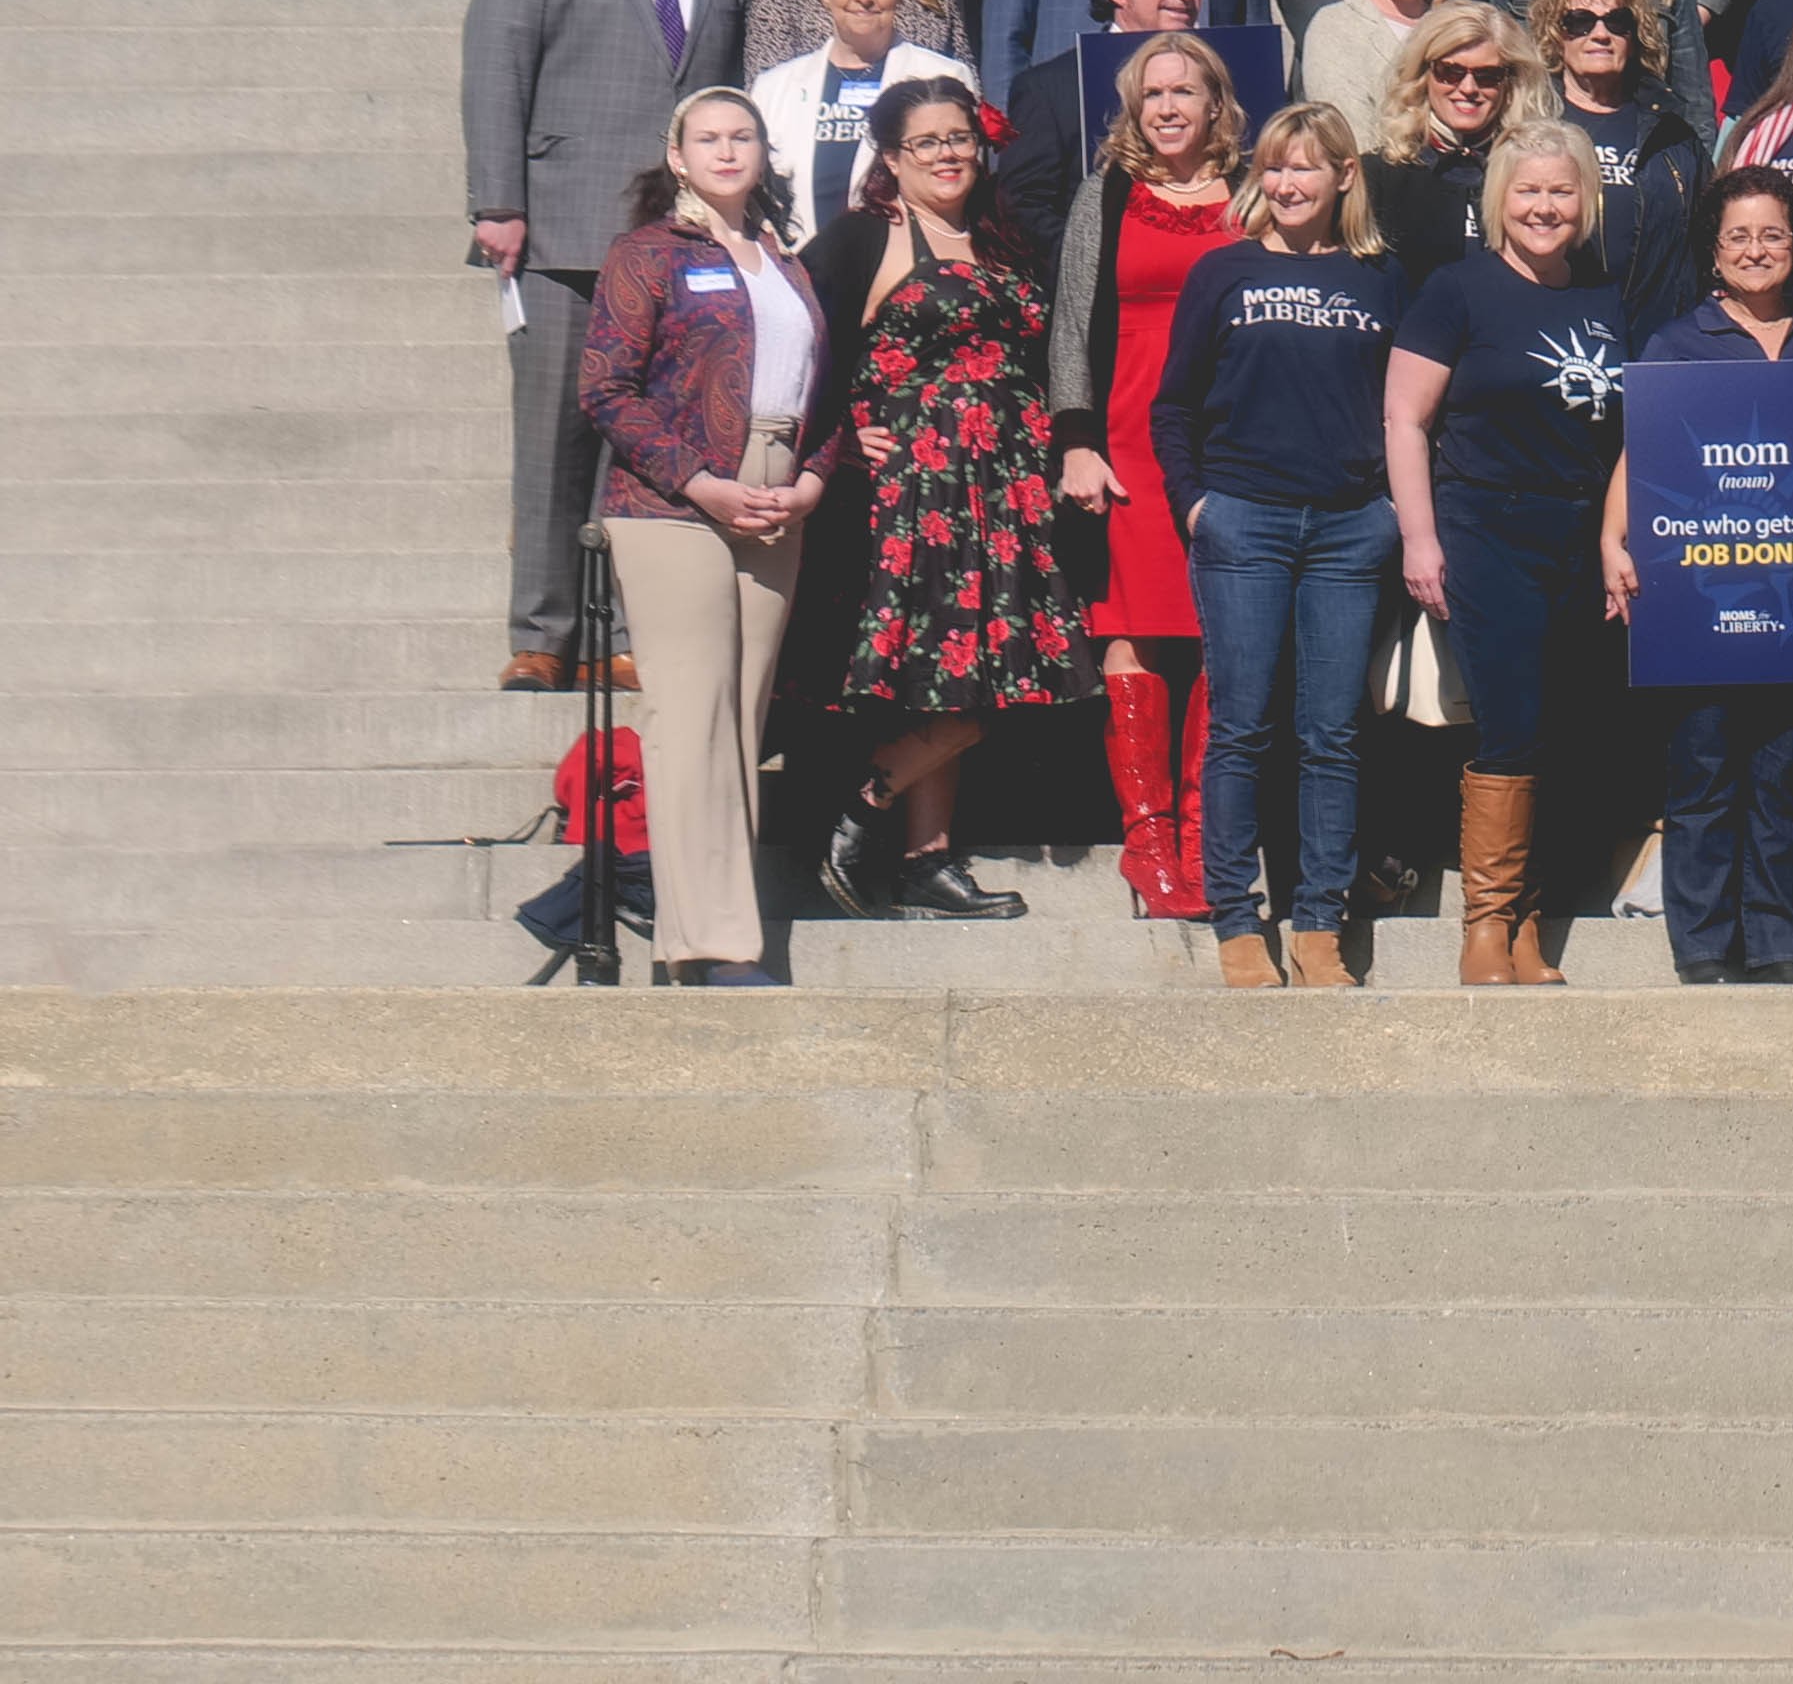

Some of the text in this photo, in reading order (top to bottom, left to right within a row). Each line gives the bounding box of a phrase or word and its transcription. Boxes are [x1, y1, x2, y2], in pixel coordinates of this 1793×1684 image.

[816, 101, 865, 121] OMS
[1243, 286, 1357, 309] MOMS for
[1244, 303, 1372, 331] LIBERTY
[1702, 441, 1790, 466] mom
[1719, 472, 1775, 492] (noun)
[1653, 516, 1698, 536] One
[1703, 514, 1751, 535] who
[1680, 544, 1729, 566] JOB
[1720, 610, 1756, 621] MOMS
[1720, 620, 1779, 633] LIBERTY
